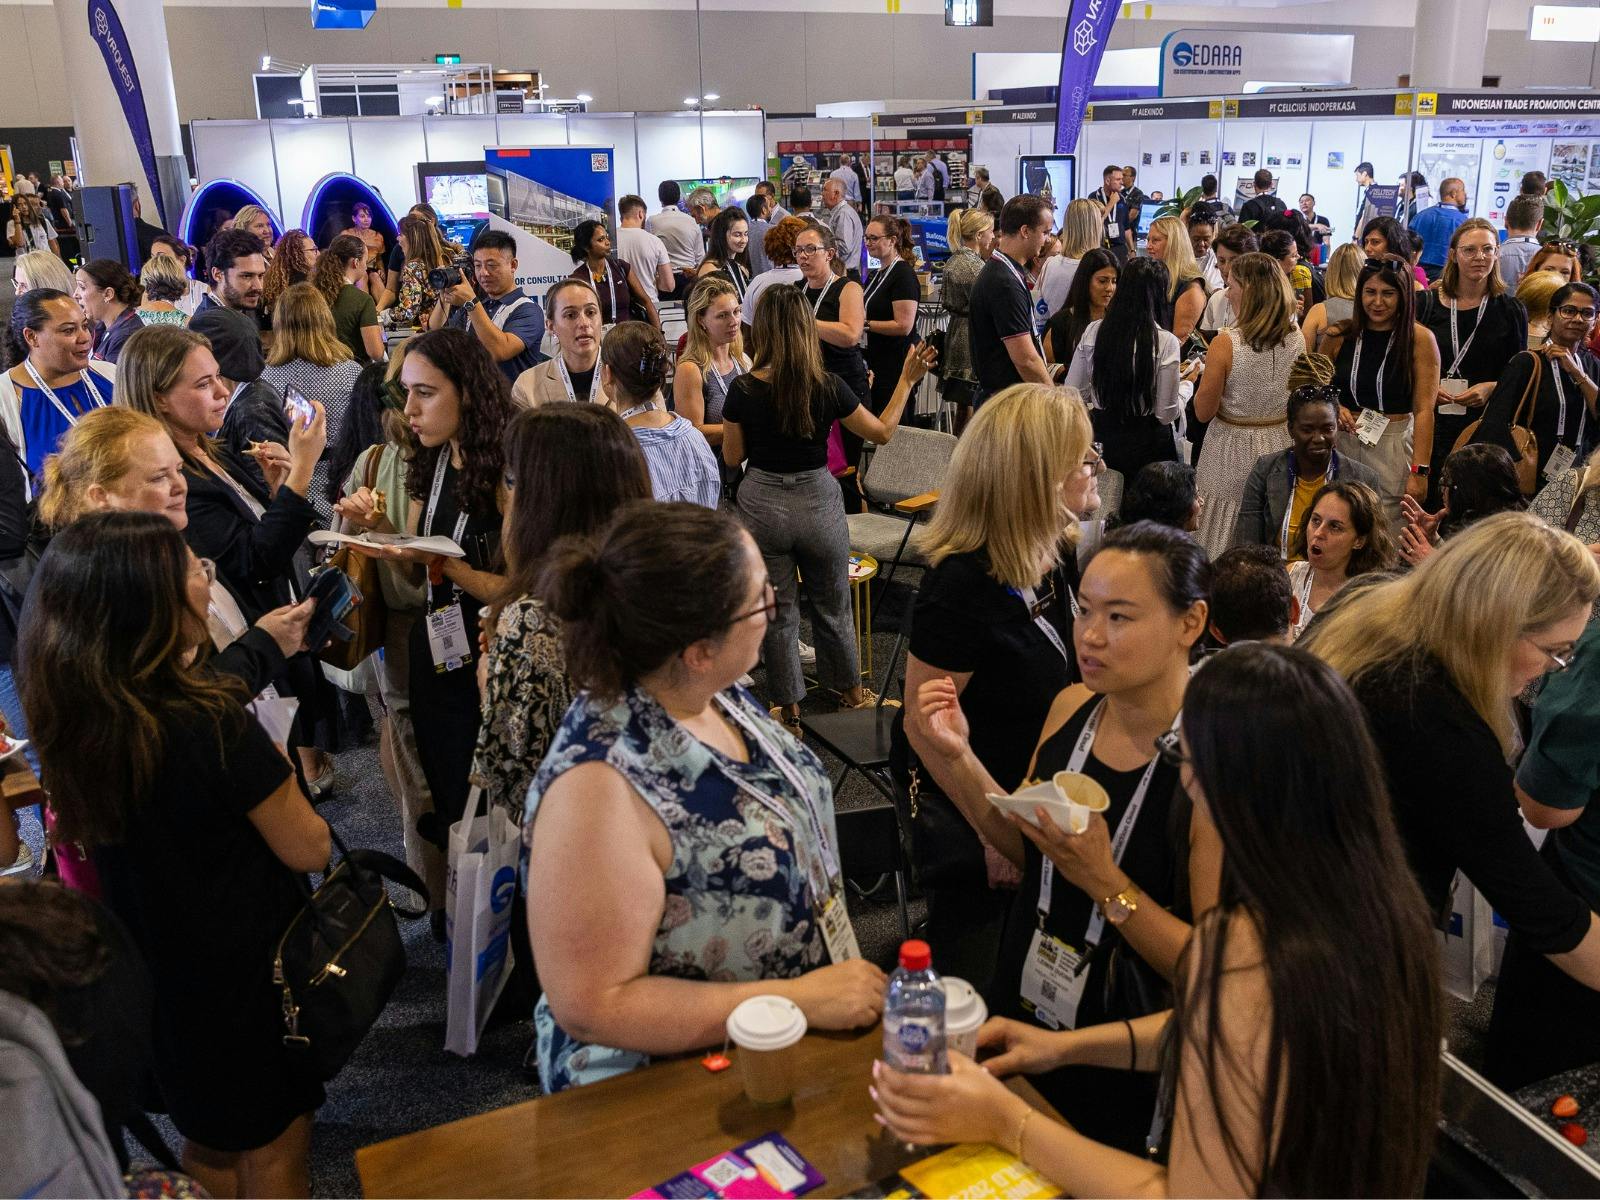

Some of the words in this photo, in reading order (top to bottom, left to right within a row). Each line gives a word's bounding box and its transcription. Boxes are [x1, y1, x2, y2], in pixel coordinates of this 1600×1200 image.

[1086, 0, 1102, 20] VR
[106, 31, 135, 92] VRQUEST
[1192, 44, 1242, 66] EDARA
[1270, 104, 1276, 112] PT
[1277, 102, 1307, 112] CELLCIUS
[1308, 101, 1356, 112] INDOPERKASA
[1452, 100, 1500, 110] INDONESIAN
[1504, 100, 1528, 110] TRADE
[1529, 100, 1577, 110] PROMOTION
[1578, 100, 1600, 110] CENTR
